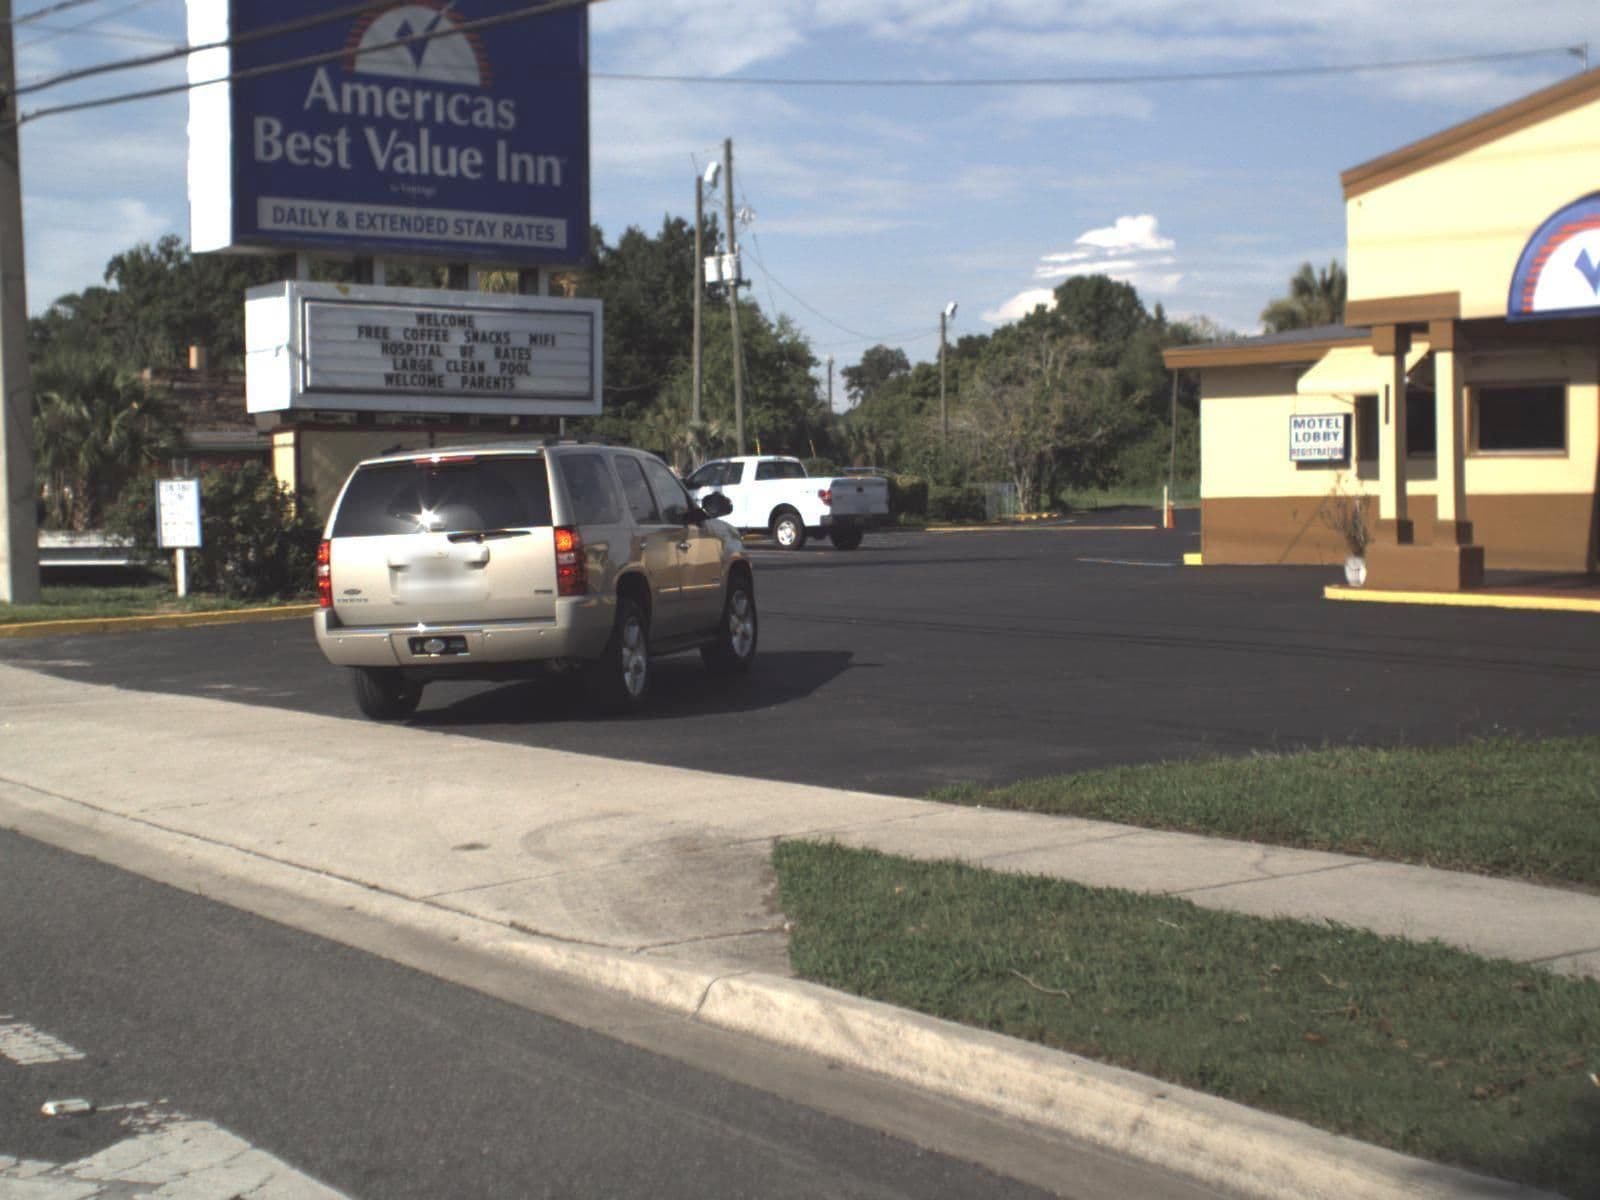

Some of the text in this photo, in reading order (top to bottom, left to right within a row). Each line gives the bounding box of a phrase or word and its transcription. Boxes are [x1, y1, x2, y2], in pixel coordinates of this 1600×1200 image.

[303, 66, 517, 131] Americas
[253, 116, 562, 187] Best Value Inn
[272, 205, 556, 243] DAILY & EXTENDED STAY RATES
[415, 312, 475, 329] WELCOME
[357, 323, 390, 340] FREE
[402, 326, 449, 342] COFFEE
[463, 330, 512, 345] SNACKS
[380, 341, 443, 358] HOSPITAL
[494, 346, 532, 361] RATES
[392, 357, 532, 377] LARGE CLEAN POOL
[384, 372, 515, 390] WELCOME PARENTS
[1293, 418, 1342, 429] MOTEL
[1294, 431, 1340, 442] LOBBY
[1290, 447, 1345, 457] REGISTRATION
